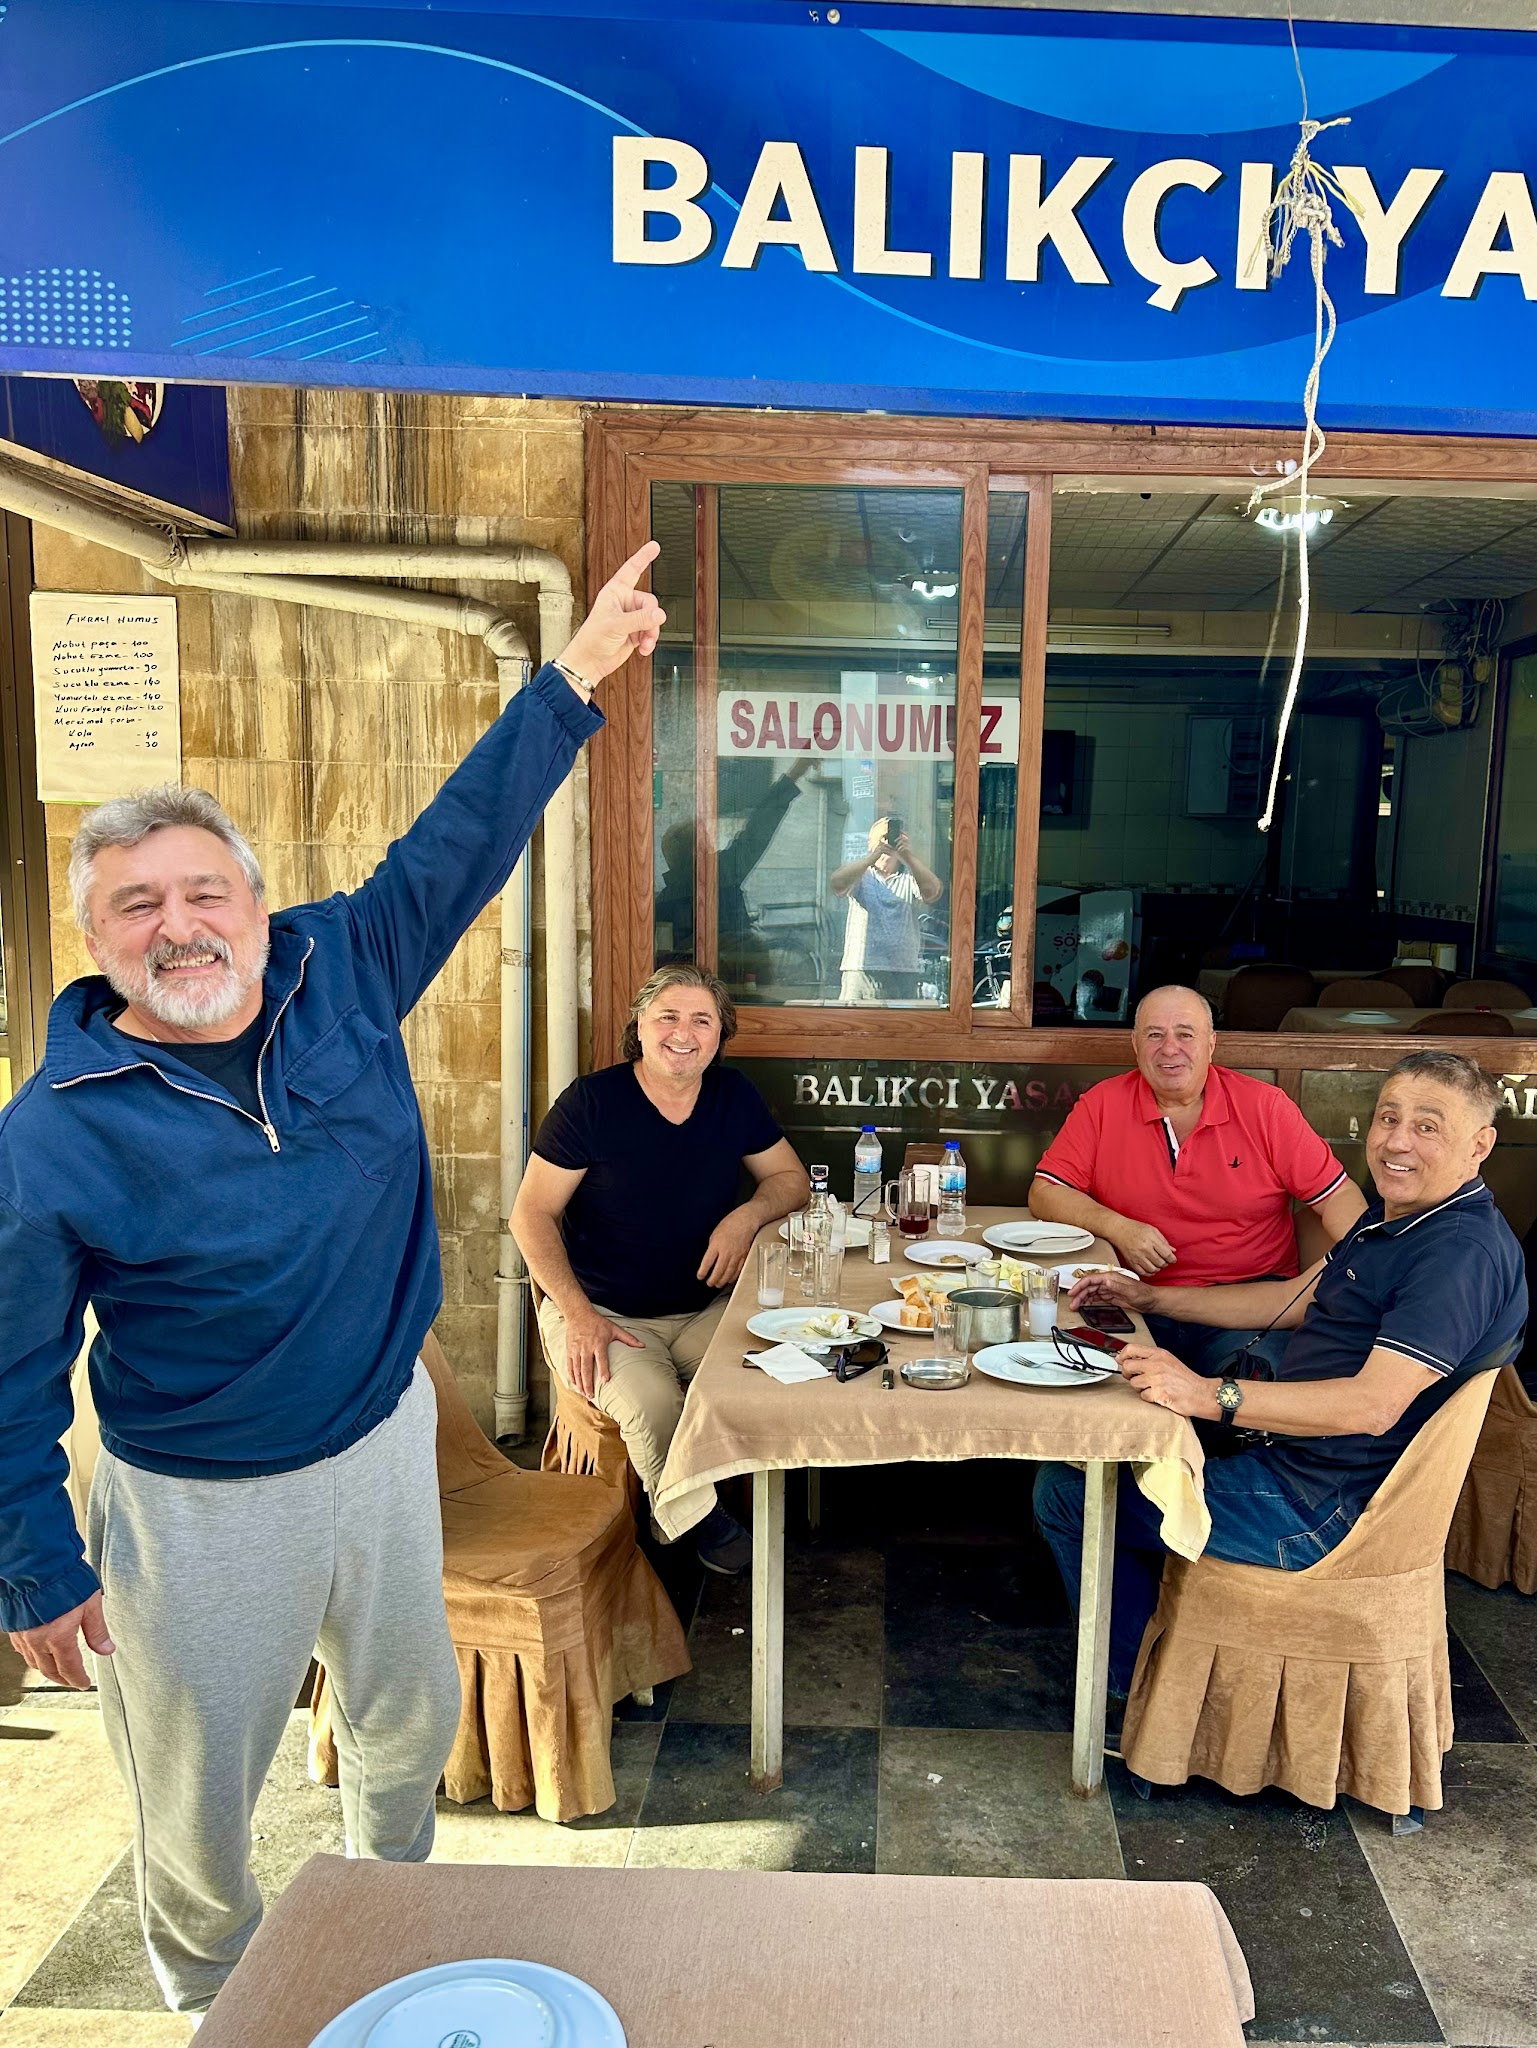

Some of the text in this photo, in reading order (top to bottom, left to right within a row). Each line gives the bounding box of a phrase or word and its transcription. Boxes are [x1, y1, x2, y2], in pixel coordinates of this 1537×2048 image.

[612, 136, 1272, 312] BALIKÇI
[118, 616, 159, 624] HUMUS
[52, 640, 86, 651] Nohut
[53, 652, 84, 661] Nohut
[144, 677, 161, 686] 140
[68, 729, 92, 737] Kola
[146, 731, 158, 739] 40
[793, 1074, 1088, 1112] BALIKCI YASA
